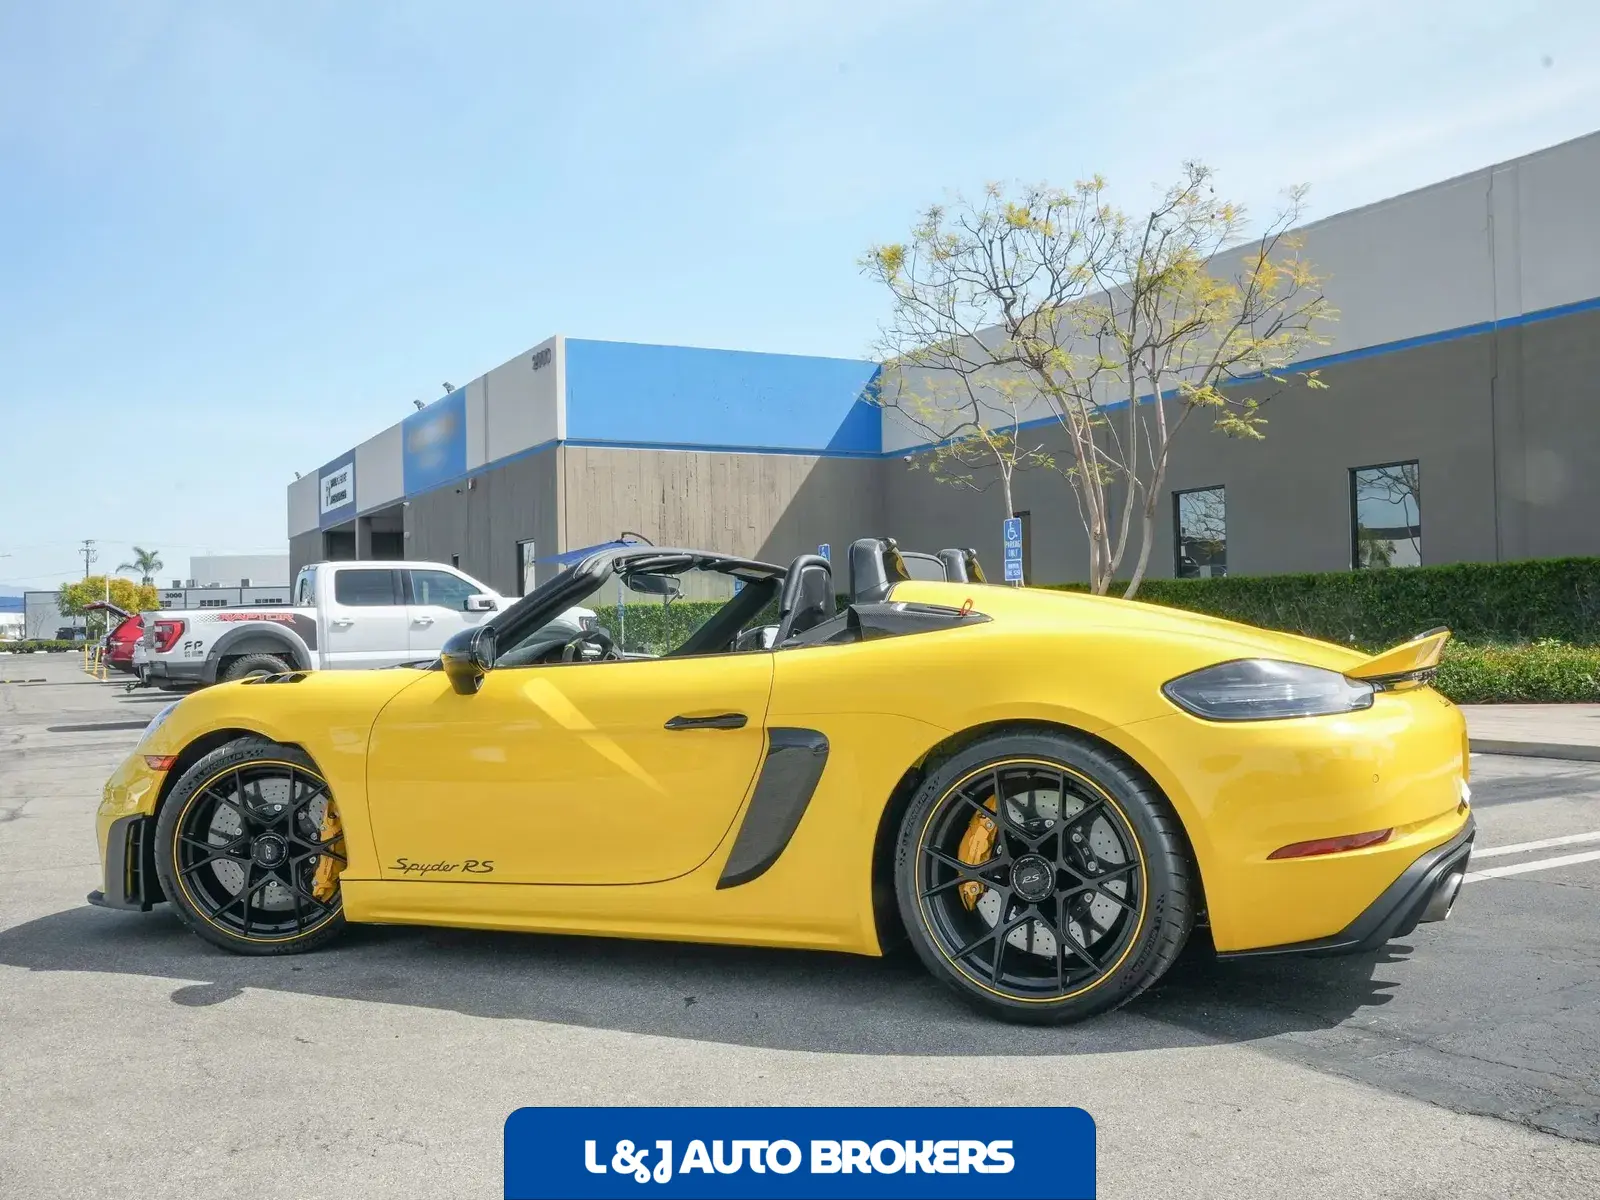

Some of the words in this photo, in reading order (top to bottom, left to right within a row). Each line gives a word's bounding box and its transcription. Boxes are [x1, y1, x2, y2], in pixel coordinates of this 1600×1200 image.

[219, 612, 296, 624] RAPTOR
[388, 858, 460, 876] Spyder
[461, 859, 494, 873] RS
[1022, 872, 1040, 884] RS
